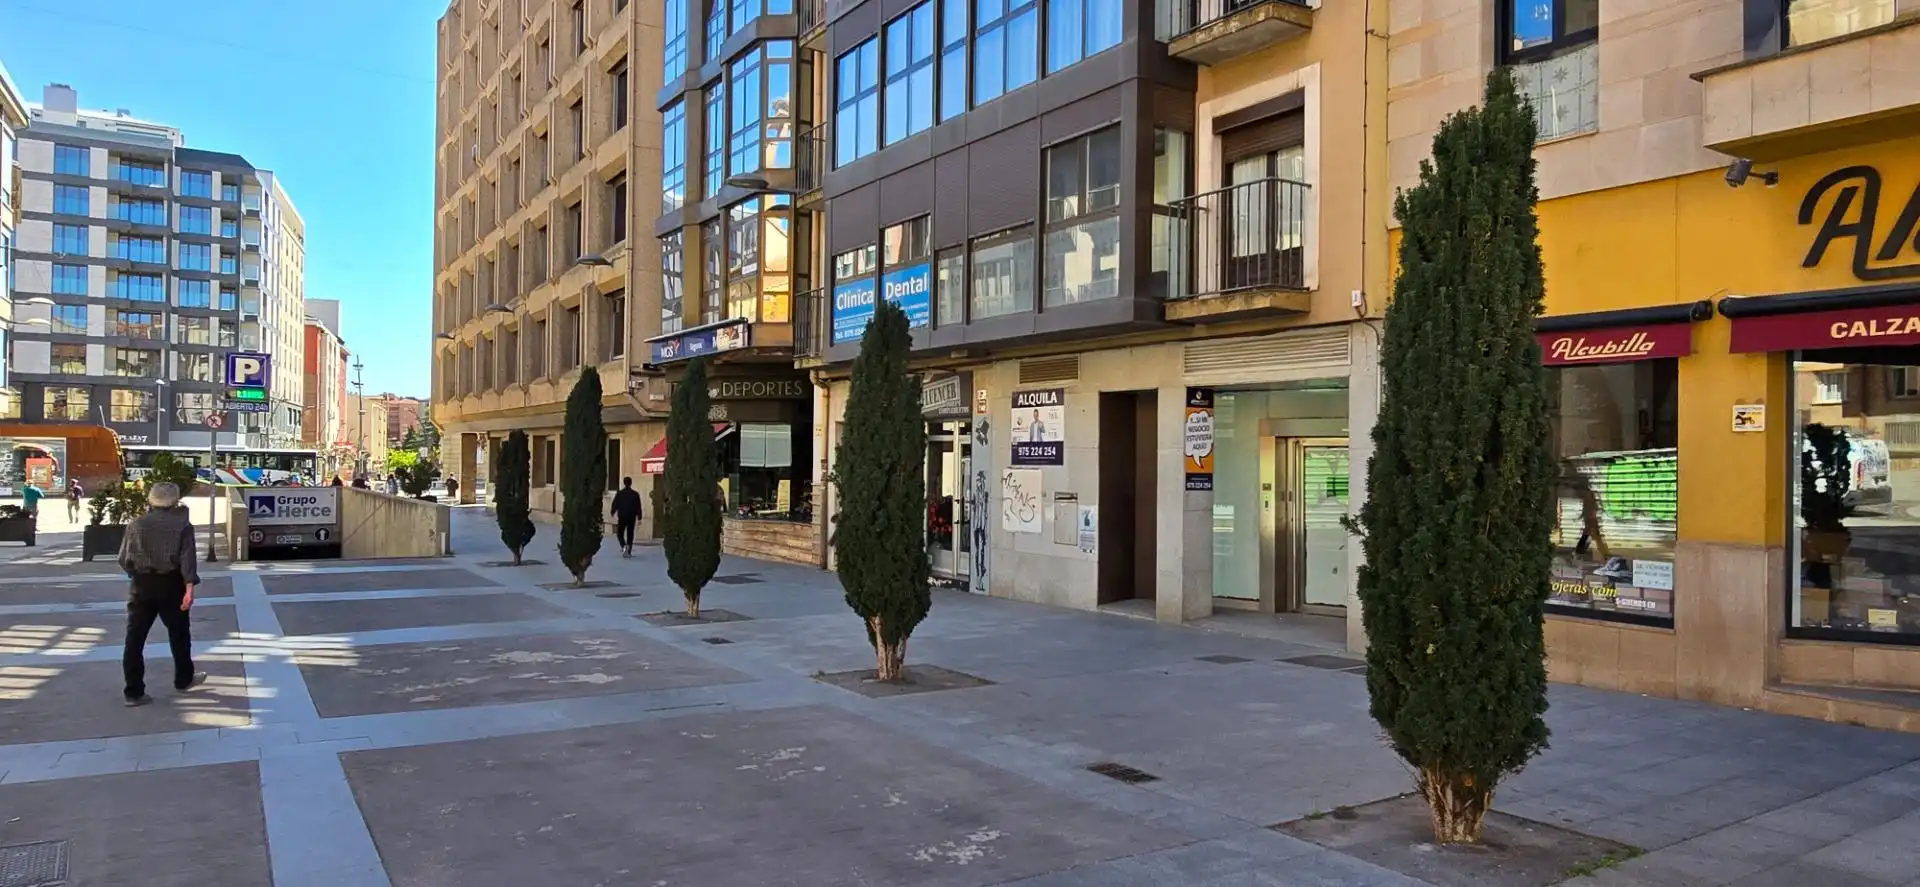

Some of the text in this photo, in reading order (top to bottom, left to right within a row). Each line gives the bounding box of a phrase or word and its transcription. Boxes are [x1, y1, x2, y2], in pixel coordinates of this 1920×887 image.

[885, 271, 928, 301] Dental
[1830, 316, 1920, 339] CALZA
[1551, 332, 1655, 360] Alcubilla
[234, 357, 260, 383] P
[722, 381, 803, 397] DEPORTES
[1018, 391, 1058, 406] ALQUILA
[1018, 446, 1056, 456] 975 224 254
[277, 495, 317, 506] Grupo
[277, 505, 331, 518] Herce
[1550, 580, 1588, 596] ojeras
